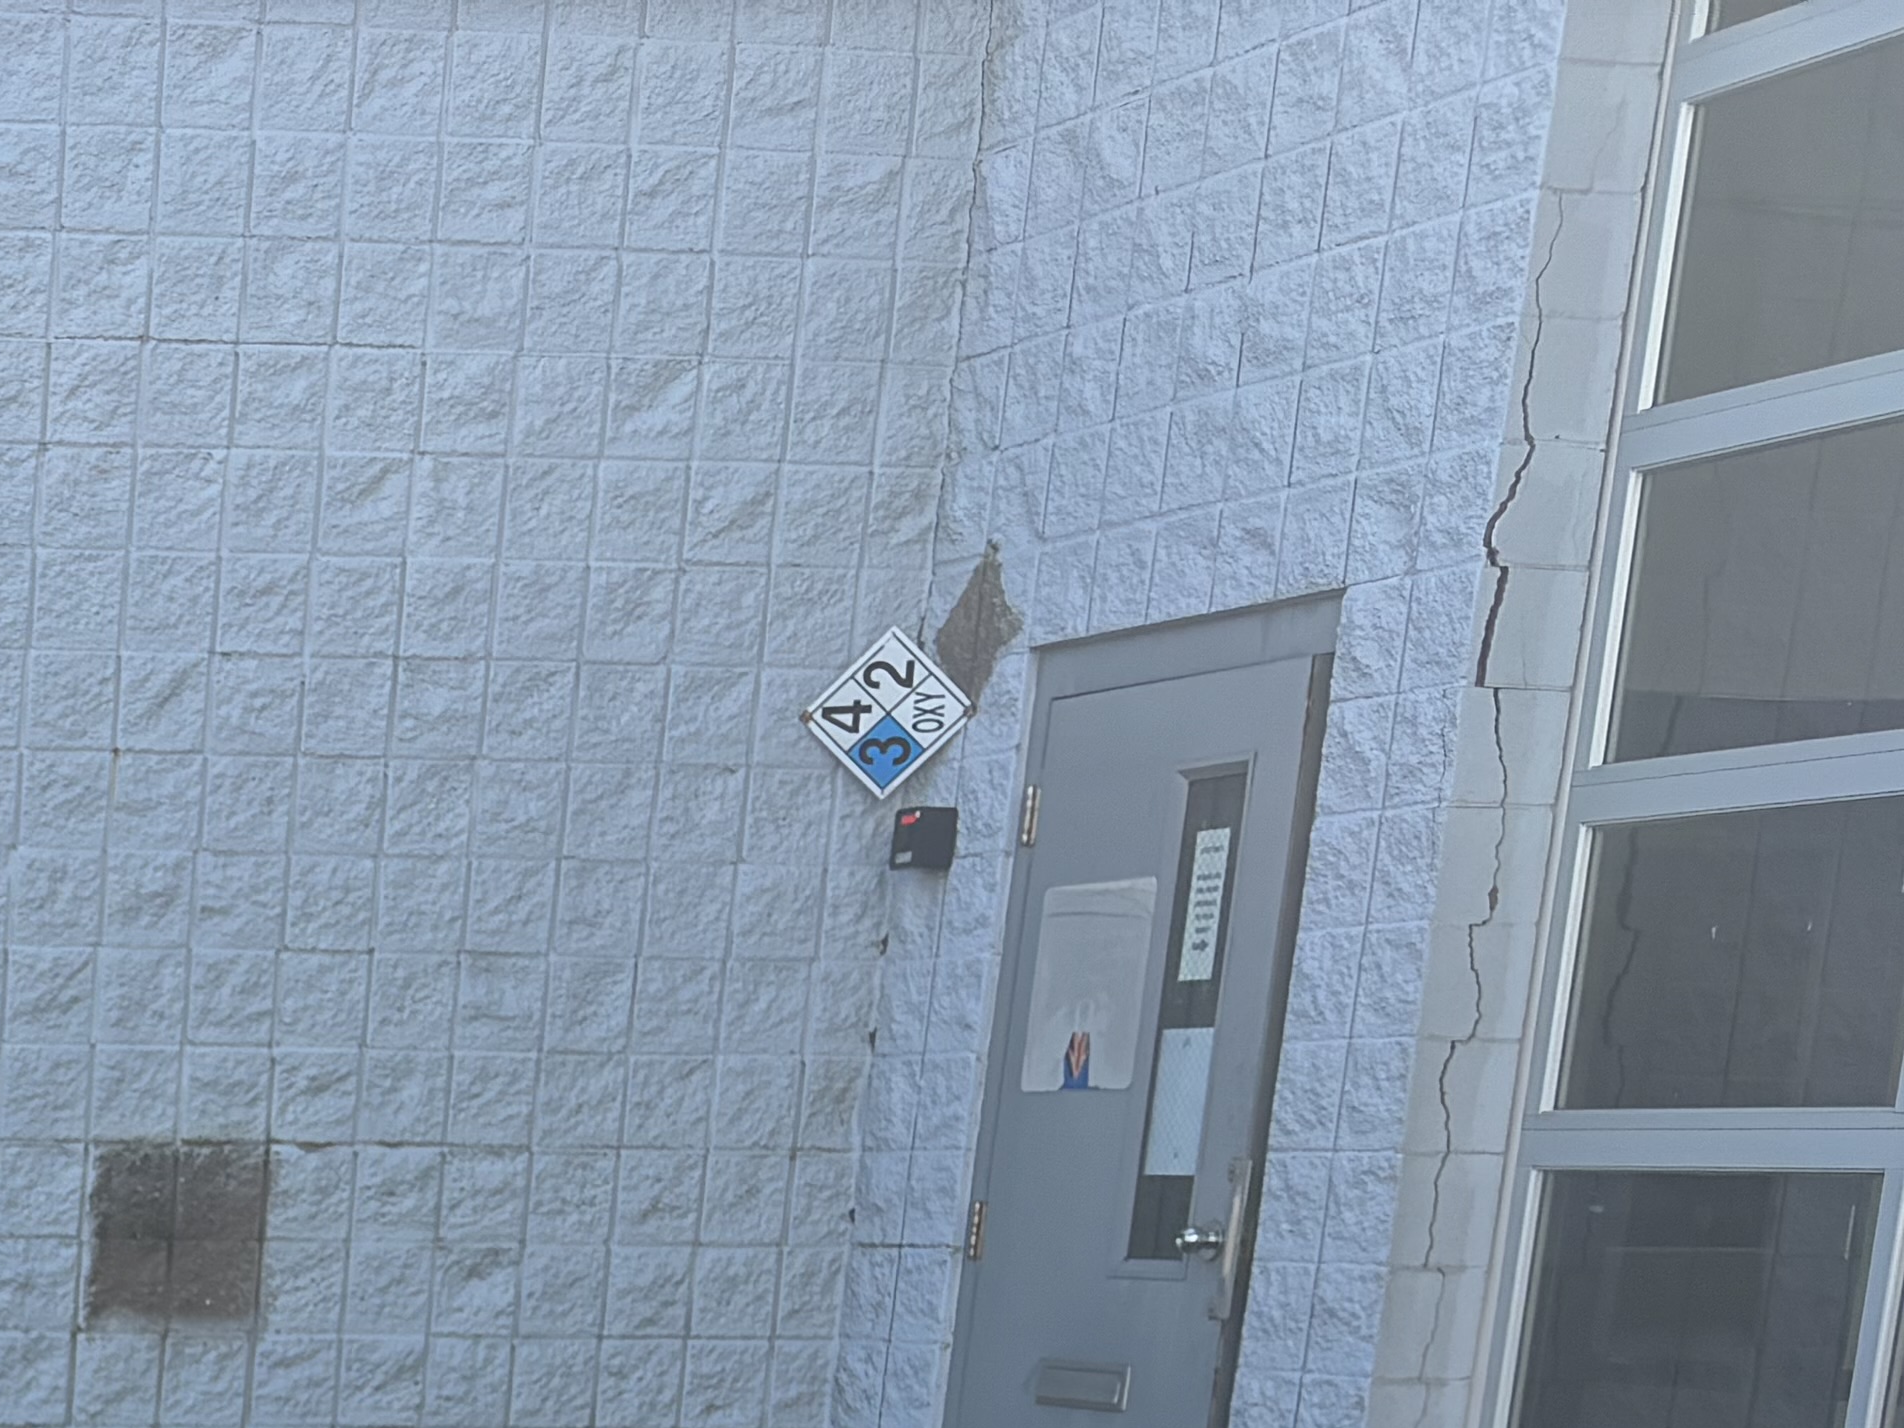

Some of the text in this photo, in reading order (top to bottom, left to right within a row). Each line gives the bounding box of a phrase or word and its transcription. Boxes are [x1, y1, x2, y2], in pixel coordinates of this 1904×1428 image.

[863, 660, 915, 689] 2
[822, 700, 873, 734] 4
[912, 692, 945, 733] OXY
[858, 736, 912, 766] 3
